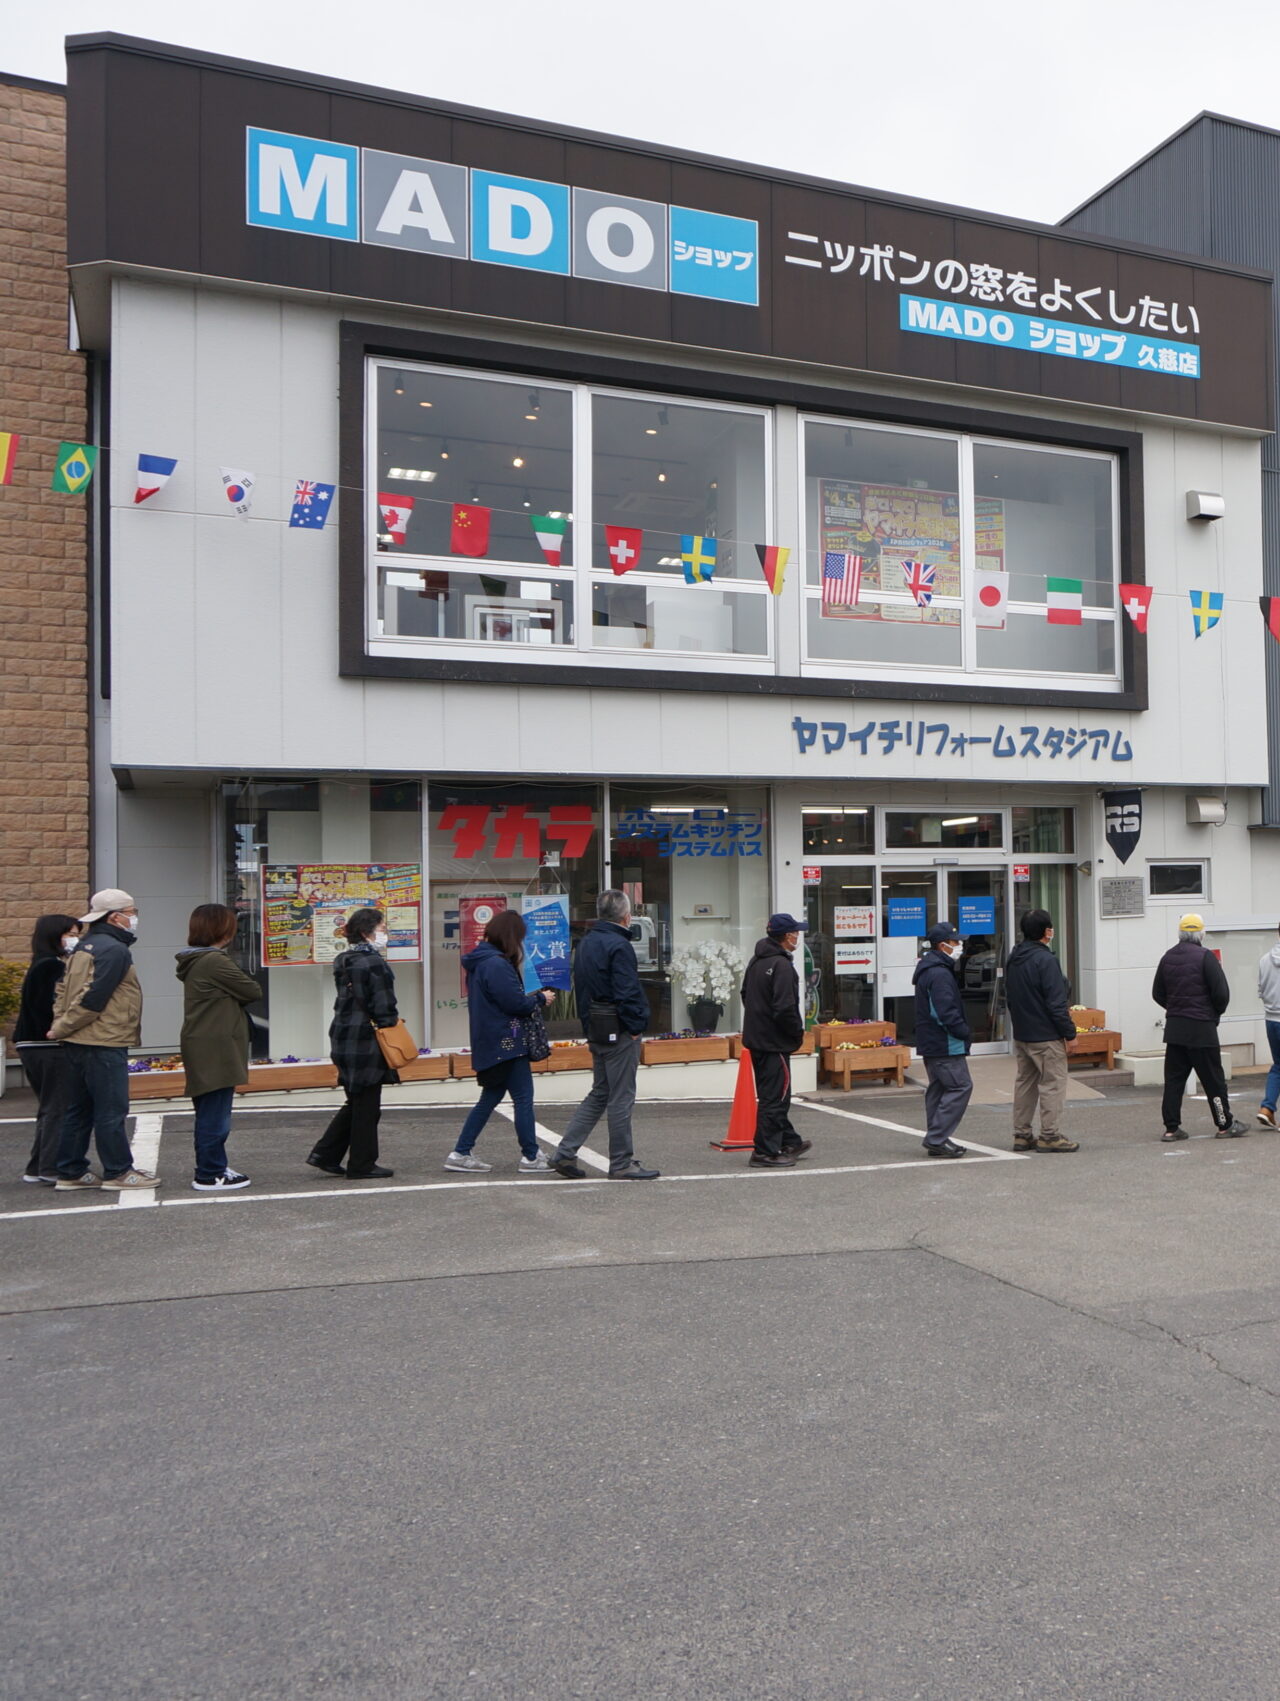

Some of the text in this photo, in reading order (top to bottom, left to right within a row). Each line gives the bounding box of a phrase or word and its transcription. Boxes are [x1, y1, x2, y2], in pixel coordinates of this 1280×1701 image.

[257, 142, 754, 274] MADO ショップ
[785, 231, 1200, 334] ニッポンの窓をよくしたい
[908, 300, 1198, 376] MADO ショップ 久慈店
[792, 716, 1133, 762] ヤマイチリフォームスタジアム
[437, 804, 595, 859] タカラ
[617, 823, 762, 838] システムキッチン
[1106, 804, 1140, 833] RS
[529, 940, 568, 960] 入賞
